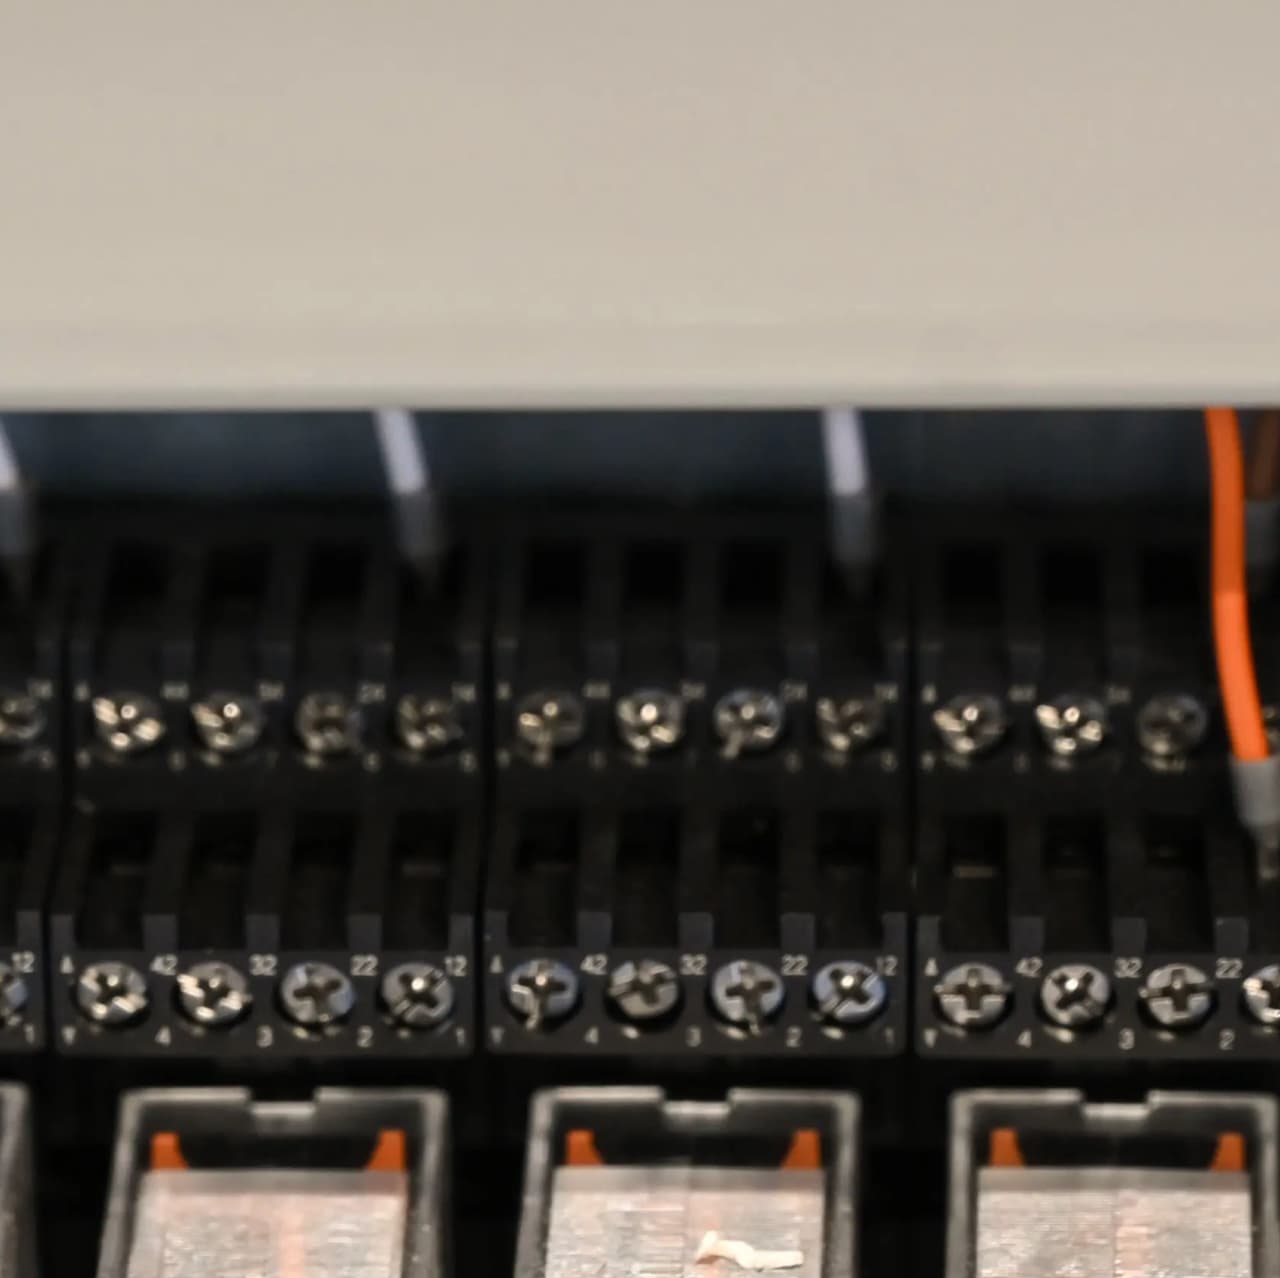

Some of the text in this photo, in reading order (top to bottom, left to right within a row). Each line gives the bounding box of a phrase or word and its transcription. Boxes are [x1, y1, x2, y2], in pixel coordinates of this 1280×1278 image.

[1016, 957, 1042, 977] 42
[1115, 958, 1141, 978] 32
[1216, 958, 1242, 978] 22
[1019, 1031, 1031, 1046] 4
[1120, 1029, 1134, 1049] 3
[1220, 1030, 1234, 1050] 2
